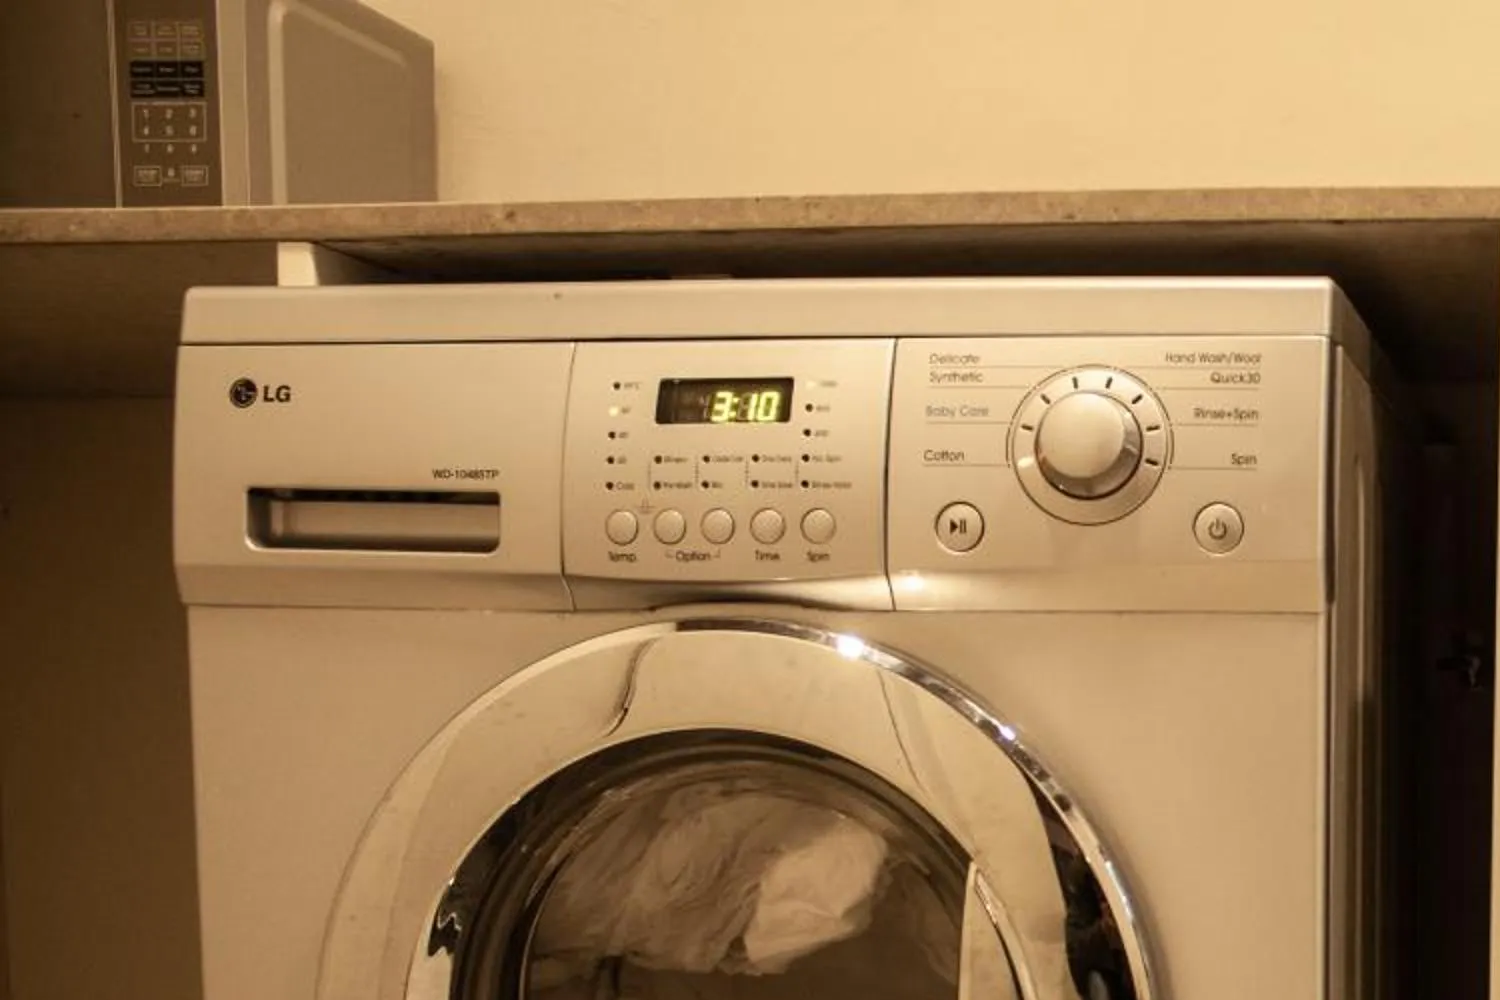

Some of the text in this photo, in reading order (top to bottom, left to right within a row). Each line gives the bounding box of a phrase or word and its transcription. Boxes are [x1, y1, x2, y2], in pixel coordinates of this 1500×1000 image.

[929, 354, 979, 364] Delicate
[1166, 353, 1262, 364] Hand Wash/Wool
[930, 372, 983, 383] Synthetic
[1211, 372, 1261, 383] Quick30
[263, 384, 291, 402] LG
[711, 391, 780, 422] 3:10
[926, 406, 989, 418] Baby Care
[1194, 408, 1259, 420] Rinse+Spin
[923, 450, 965, 461] Cotton
[1231, 453, 1257, 465] Spin
[675, 550, 711, 562] Option
[755, 550, 780, 561] Time
[807, 551, 831, 563] Spin
